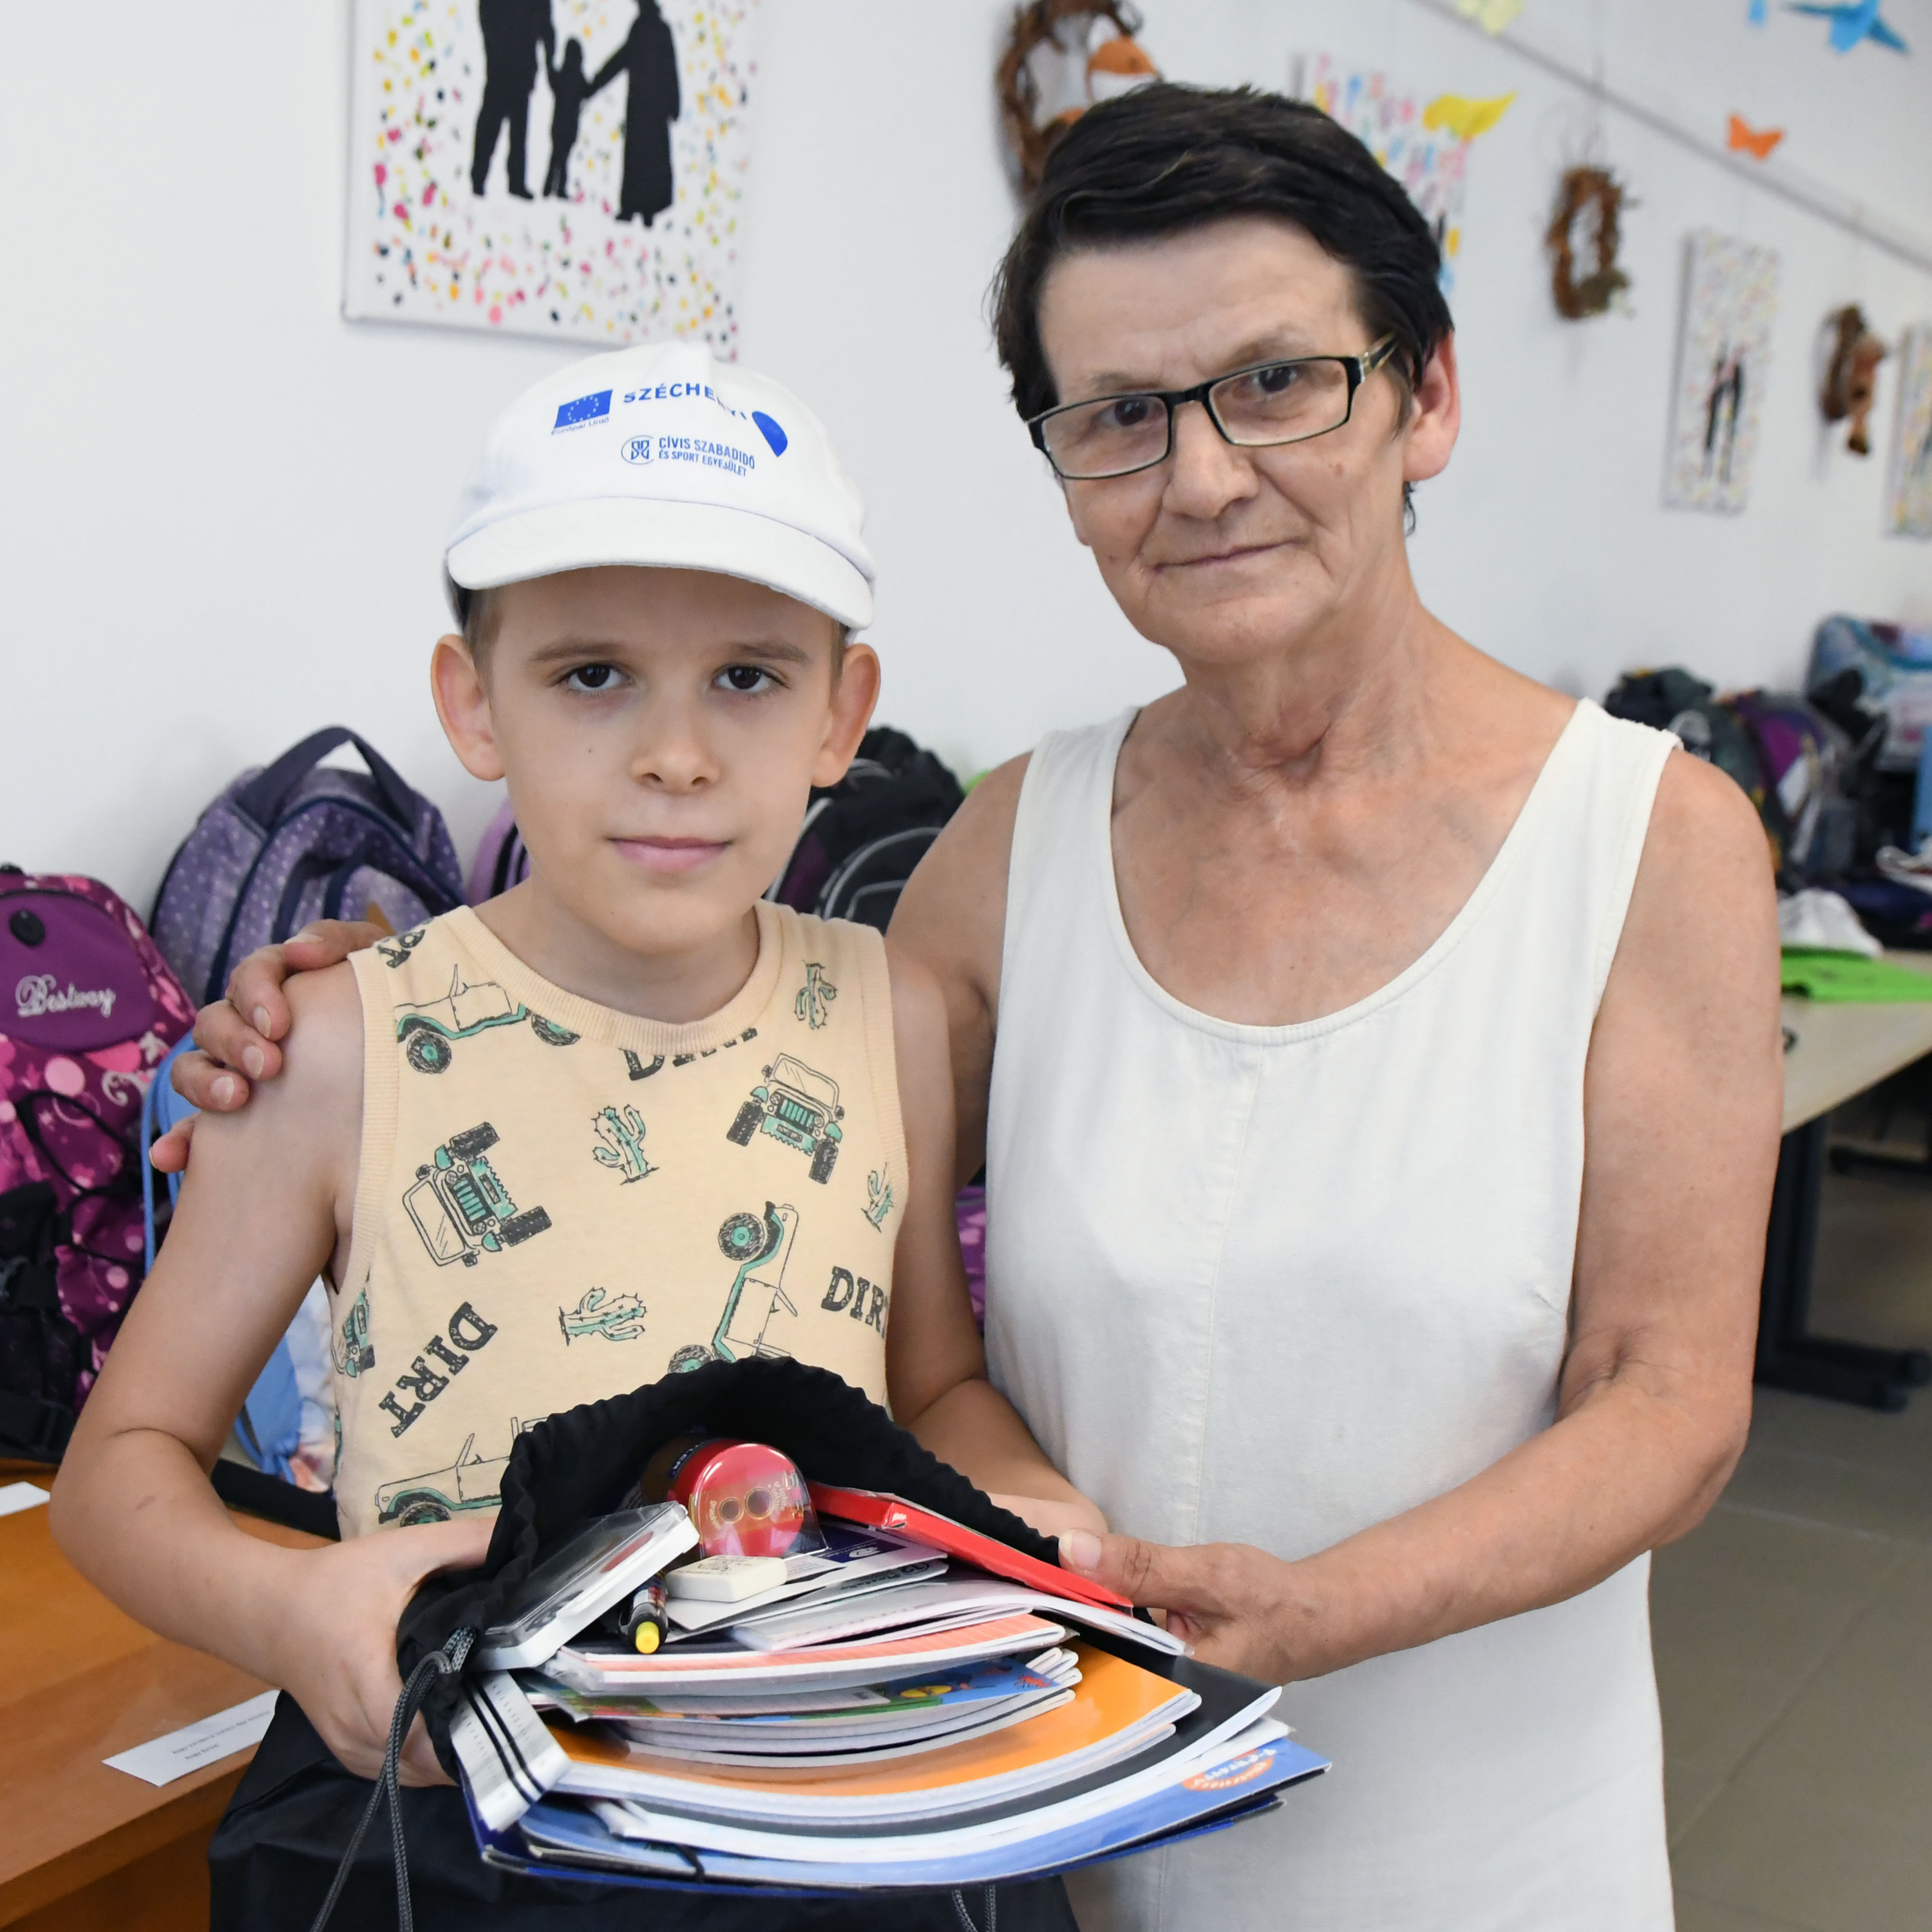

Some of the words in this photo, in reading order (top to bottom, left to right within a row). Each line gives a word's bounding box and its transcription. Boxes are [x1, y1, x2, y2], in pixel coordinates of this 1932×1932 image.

[623, 383, 747, 420] SZÉCHE
[659, 435, 691, 450] CÍVIS
[659, 450, 670, 460] ÉS
[672, 451, 699, 462] SPORT
[820, 1265, 889, 1340] DIR
[379, 1301, 498, 1439] DIRT
[710, 1499, 723, 1531] graphite
